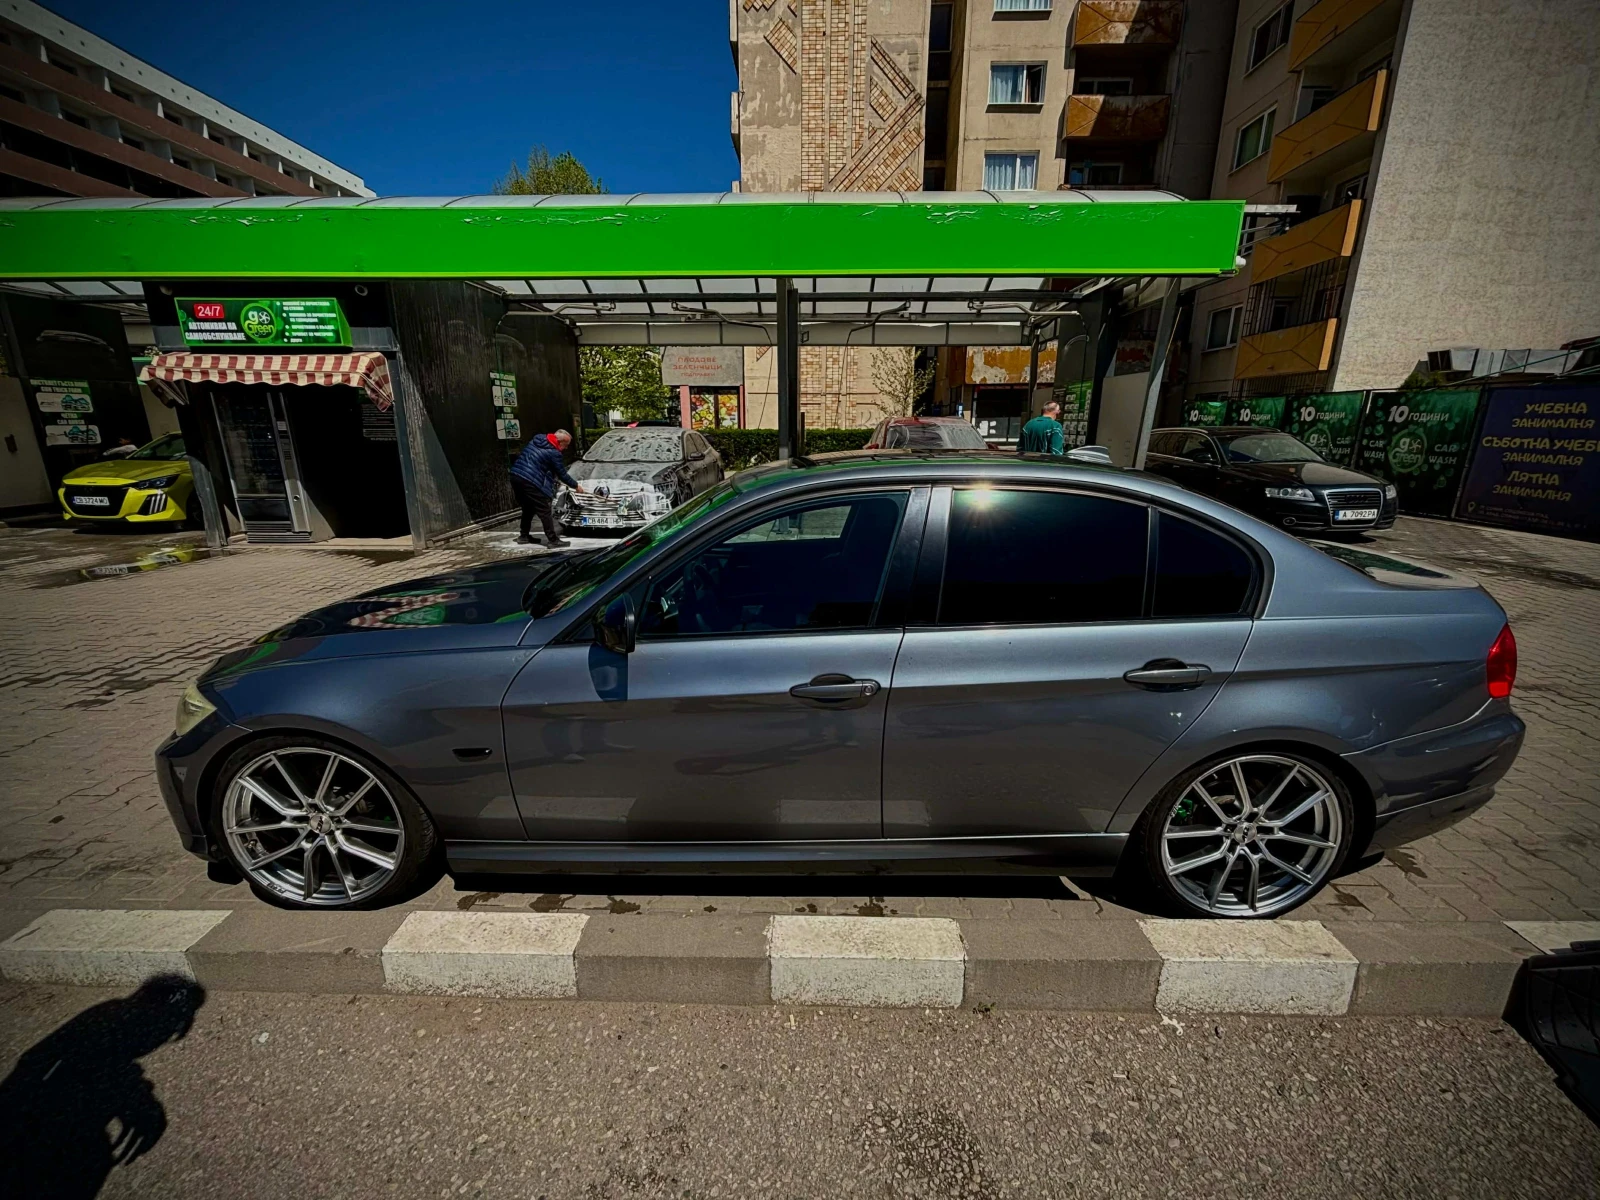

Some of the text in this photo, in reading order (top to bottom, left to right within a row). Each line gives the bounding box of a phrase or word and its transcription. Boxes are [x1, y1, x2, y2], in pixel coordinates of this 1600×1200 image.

[197, 305, 221, 317] 24/7
[188, 322, 237, 330] АВТОМИВКА НА
[244, 320, 275, 333] Green
[185, 332, 246, 341] САМООБСЛУЖВАНЕ
[1300, 406, 1316, 422] 10
[1387, 405, 1409, 423] 10
[1524, 402, 1588, 414] УЧЕБНА
[1189, 409, 1199, 422] 10
[1239, 408, 1251, 422] 10
[1511, 418, 1596, 429] ЗАНИМАЛНЯ
[1369, 440, 1384, 448] CAR
[1434, 444, 1457, 453] CAR
[1482, 436, 1551, 449] СЪБОТНА
[1363, 450, 1385, 459] WASH
[1391, 447, 1422, 464] Green
[1428, 455, 1458, 465] WASH
[1502, 452, 1584, 466] ЗАНИМАЛНЯ
[1507, 470, 1560, 486] ЛЯТНА
[1492, 484, 1572, 502] ЗАНИМАЛНЯ
